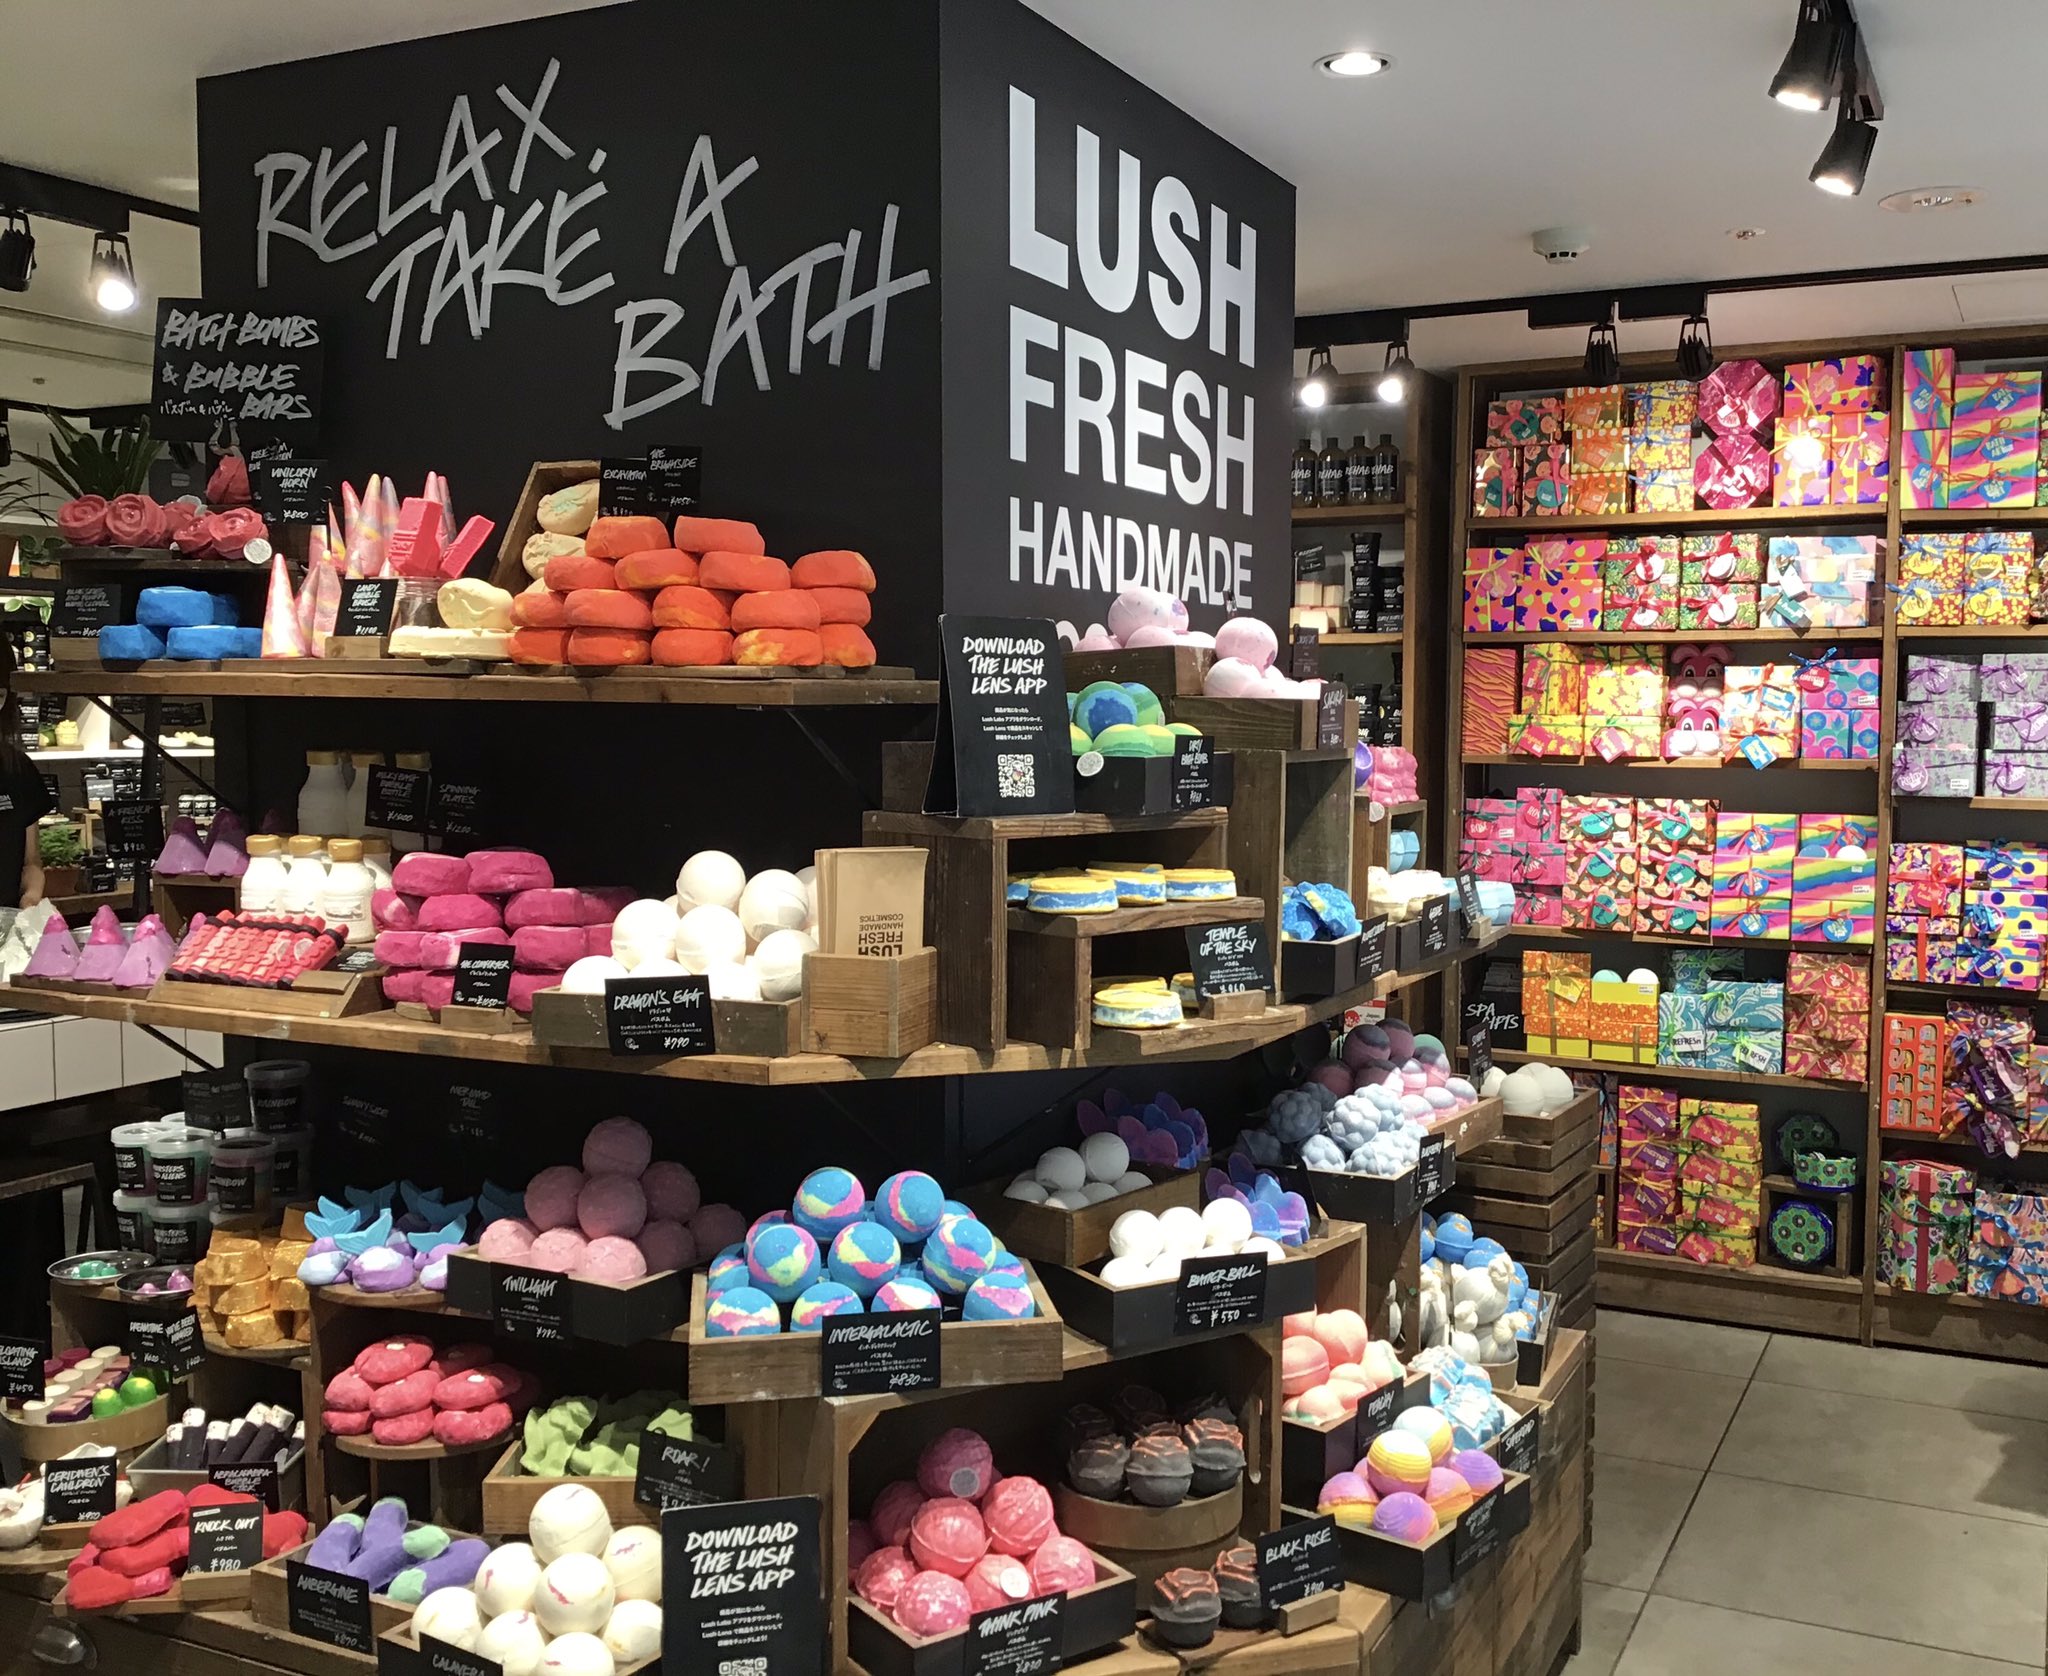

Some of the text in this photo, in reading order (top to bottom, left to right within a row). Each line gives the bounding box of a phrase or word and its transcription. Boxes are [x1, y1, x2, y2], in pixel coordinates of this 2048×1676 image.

[1009, 84, 1257, 368] LUSH
[366, 134, 759, 359] TAKE A
[603, 203, 930, 430] BATH
[161, 308, 320, 352] BATH BOMBS
[184, 361, 300, 394] BUBBLE
[239, 391, 312, 420] BARS
[1009, 305, 1254, 516] FRESH
[271, 467, 318, 478] UNICORN
[279, 478, 309, 489] HORN
[1009, 496, 1253, 609] HANDMADE
[962, 637, 1045, 655] DOWNLOAD
[968, 654, 1045, 675] THE LUSH
[971, 676, 1048, 695] LENS APP
[859, 913, 904, 923] COSMETICS
[859, 922, 904, 931] HANDMADE
[858, 931, 903, 945] FRESH
[1205, 925, 1248, 942] TEMPLE
[858, 944, 903, 957] LUSH
[1200, 938, 1257, 956] OF THE SKY
[614, 987, 704, 1012] DRAGON'S EGG
[1466, 1002, 1496, 1017] SPA
[664, 1036, 690, 1049] ¥790
[502, 1275, 558, 1299] TWILIGHT
[1187, 1264, 1262, 1288] BUTTER BALL
[828, 1320, 933, 1344] INTERGALACTIC
[889, 1373, 921, 1389] ¥830
[50, 1477, 106, 1493] CAULDRON
[194, 1516, 259, 1533] KNOCK OUT
[684, 1522, 799, 1553] DOWNLOAD
[1266, 1527, 1331, 1565] BLACK ROSE
[210, 1558, 241, 1571] ¥980
[690, 1544, 795, 1575] THE LUSH
[690, 1568, 795, 1599] LENS APP
[978, 1598, 1058, 1638] THINK PINK
